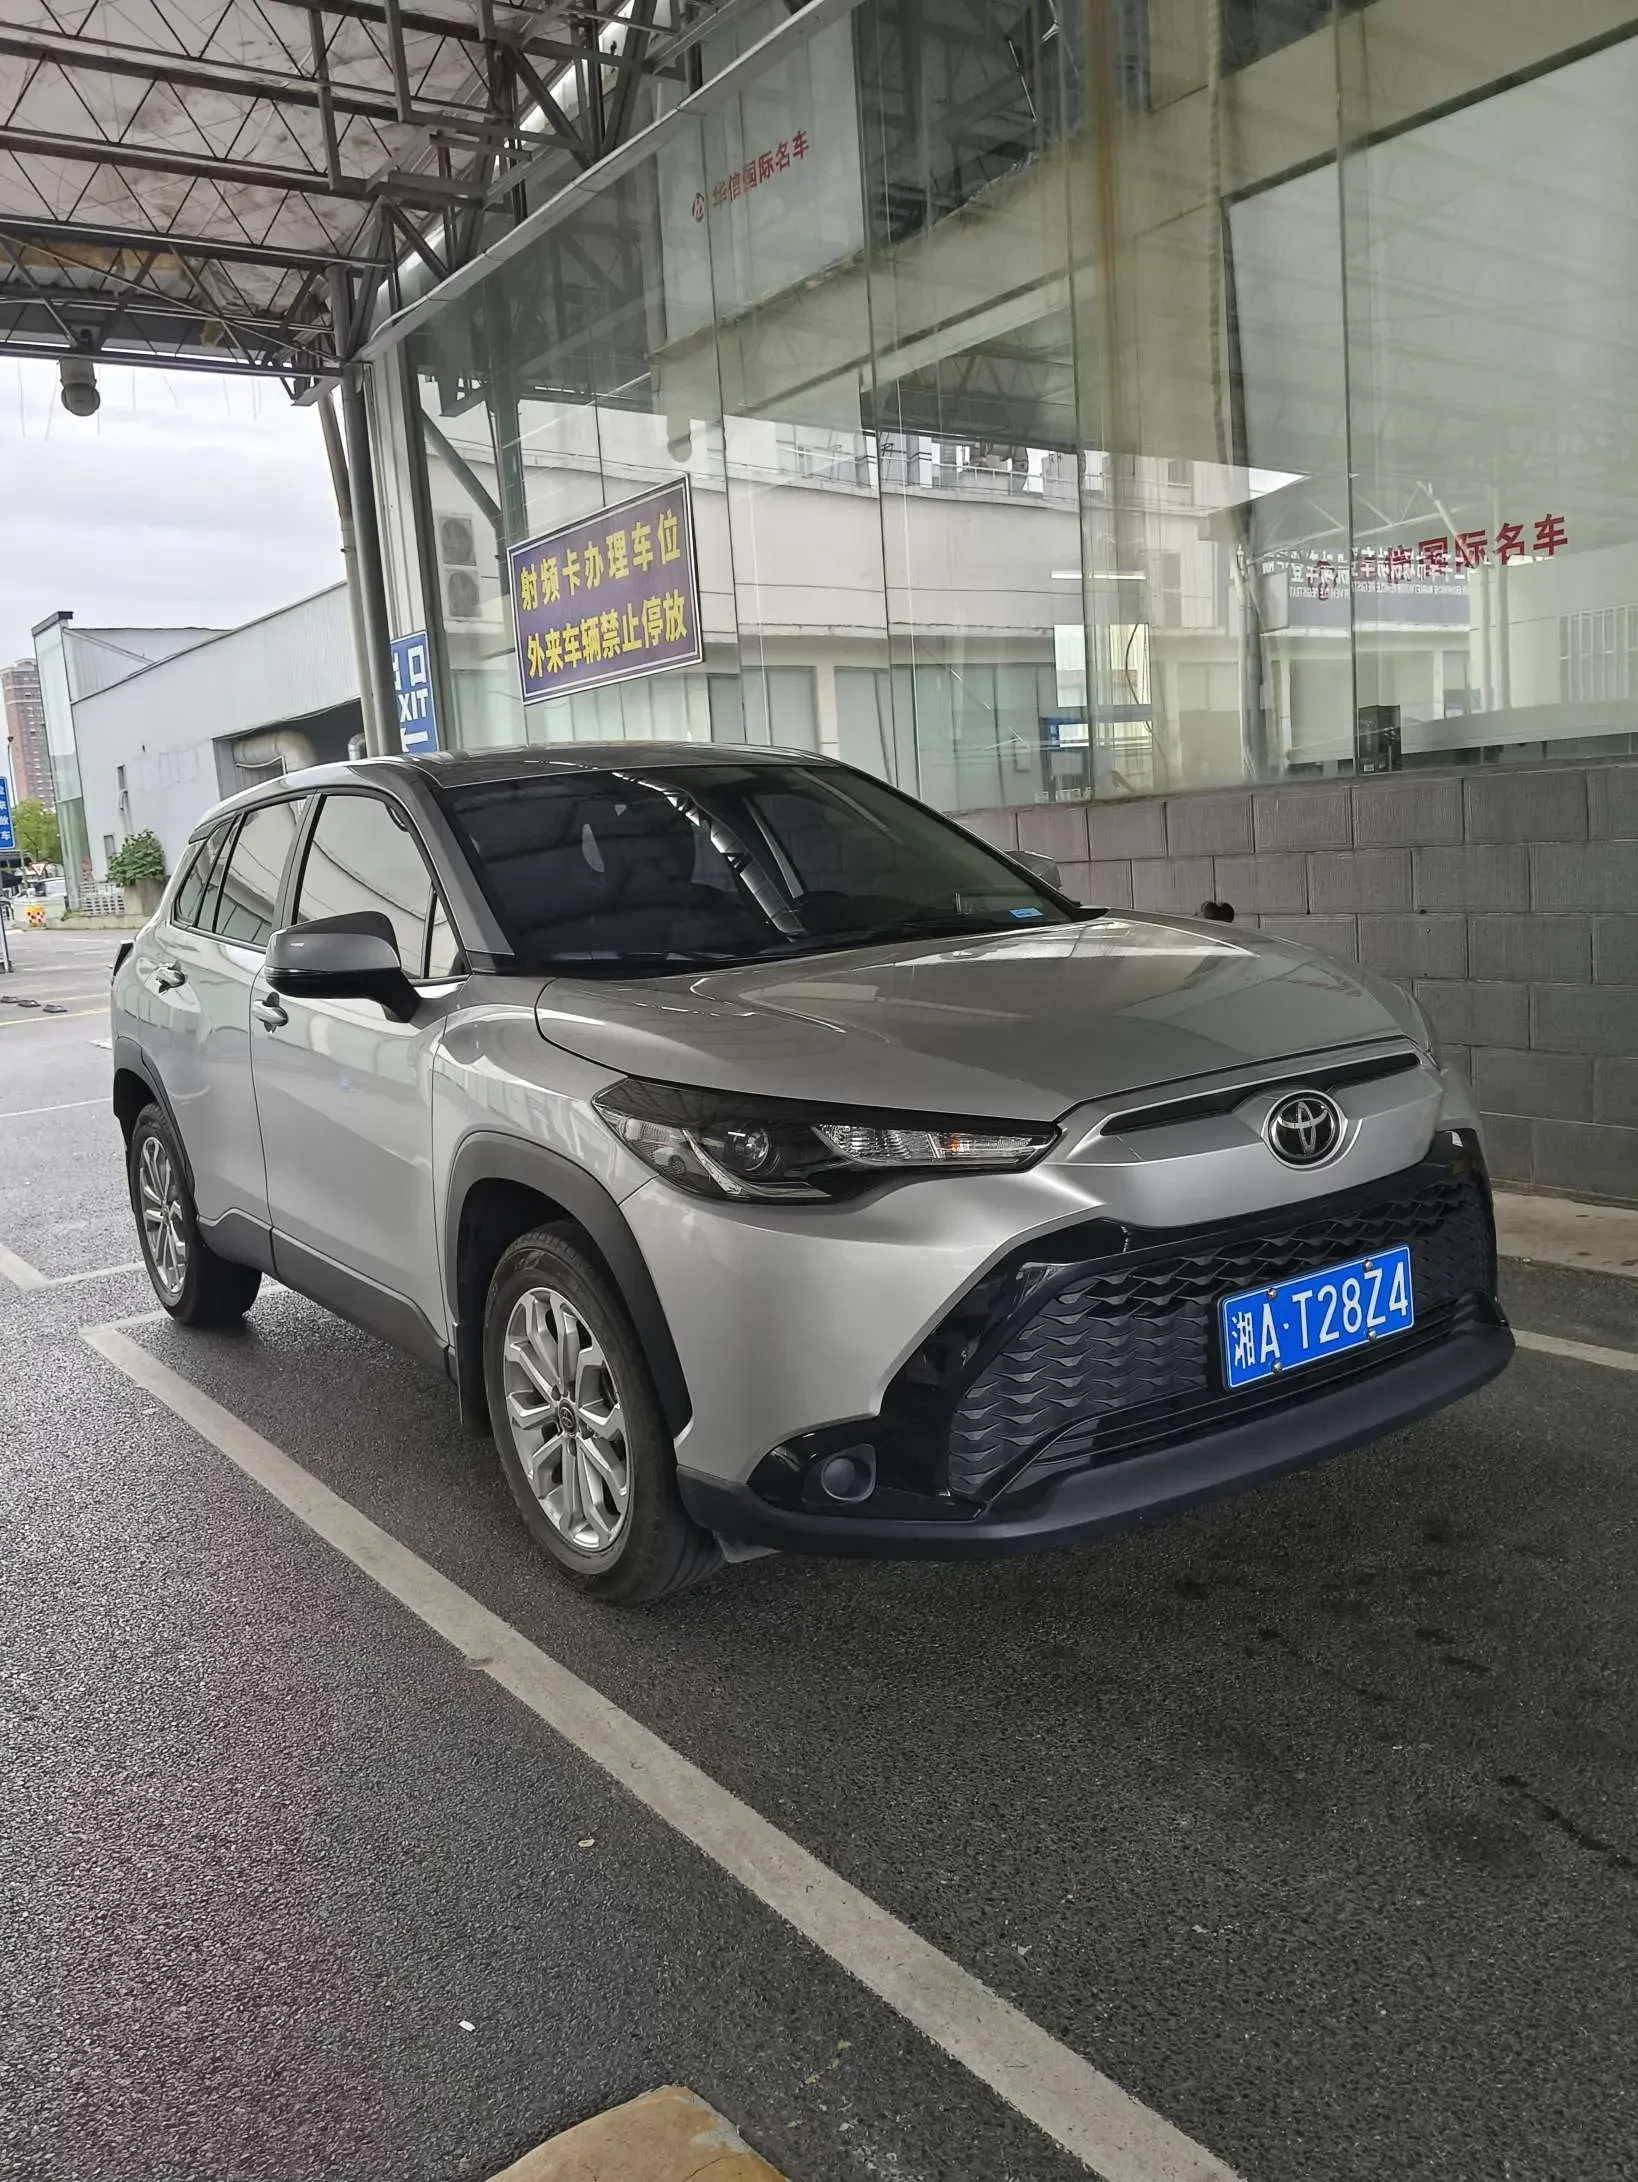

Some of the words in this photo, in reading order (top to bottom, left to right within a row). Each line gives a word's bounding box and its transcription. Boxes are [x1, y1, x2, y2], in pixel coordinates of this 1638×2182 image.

[712, 129, 810, 210] 华信国际名车
[520, 509, 681, 611] 射频卡办理车位
[392, 645, 427, 691] 口
[527, 588, 688, 680] 外来车辆禁止停放
[398, 688, 428, 723] XIT
